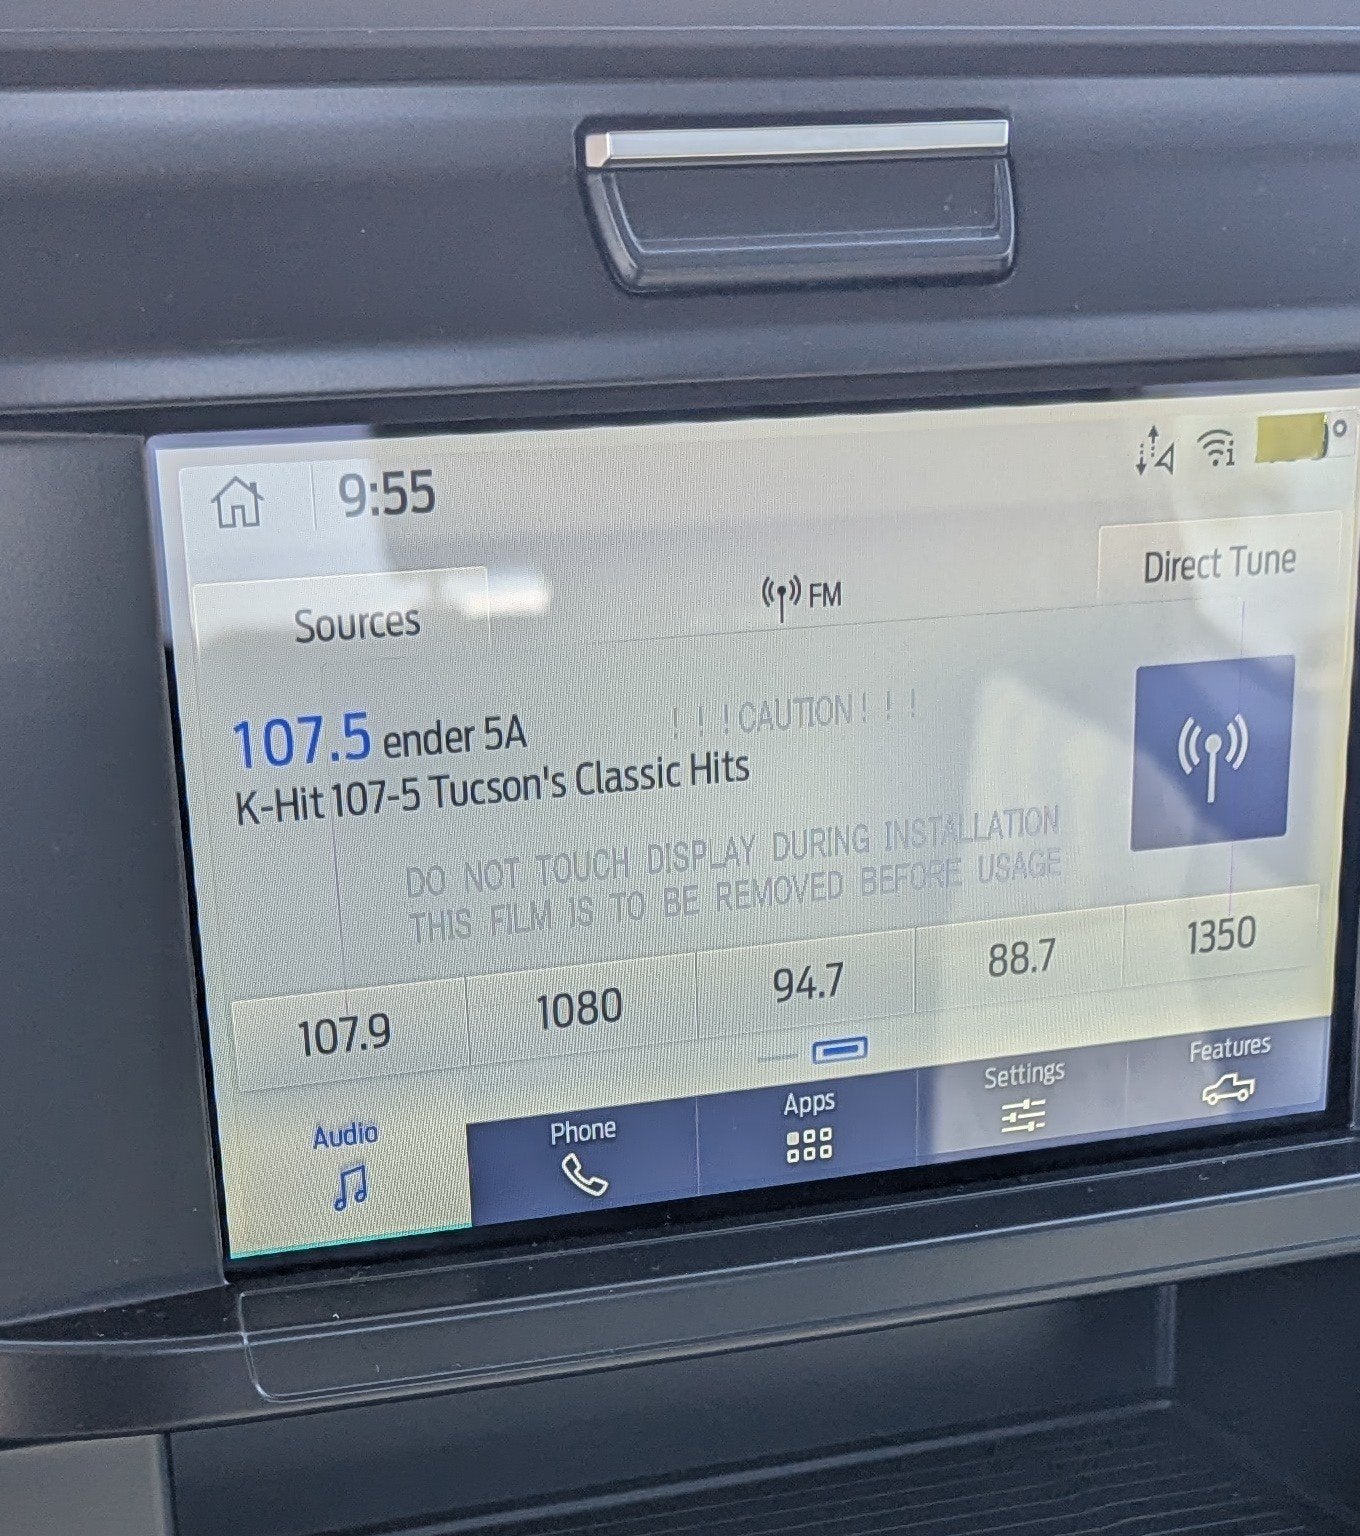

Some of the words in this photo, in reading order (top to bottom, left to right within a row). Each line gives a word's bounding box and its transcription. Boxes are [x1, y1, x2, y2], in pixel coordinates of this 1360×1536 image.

[339, 467, 436, 518] 9:55
[1144, 548, 1222, 584] Direct
[1229, 545, 1297, 578] Tune
[809, 582, 842, 608] FM
[294, 607, 421, 644] Sources
[233, 711, 372, 769] 107.5
[382, 719, 476, 759] ender
[484, 713, 528, 751] 5A
[235, 787, 326, 827] K-Hit
[332, 776, 422, 818] 107-5
[428, 765, 567, 810] Tucson's
[575, 756, 682, 797] Classic
[689, 750, 751, 787] Hits
[405, 864, 446, 899] DO
[464, 856, 521, 896] NOT
[535, 846, 632, 889] TOUCH
[647, 833, 758, 876] DISPLAY
[772, 822, 871, 864] DURING
[884, 804, 1062, 853] INSTALLATION
[409, 907, 473, 946] THIS
[489, 899, 554, 938] FILM
[568, 895, 595, 929] IS
[609, 889, 645, 923] TO
[663, 883, 699, 920] BE
[715, 870, 845, 914] REMOVED
[860, 856, 963, 896] BEFORE
[977, 846, 1063, 885] USAGE
[1187, 914, 1258, 955] 1350
[988, 937, 1058, 979] 88.7
[772, 961, 845, 1003] 94.7
[537, 986, 624, 1030] 1080
[298, 1011, 392, 1058] 107.9
[1189, 1033, 1273, 1064] Features
[984, 1059, 1067, 1091] Settings
[782, 1090, 837, 1118] Apps
[312, 1118, 380, 1150] Audio
[550, 1116, 618, 1147] Phone
